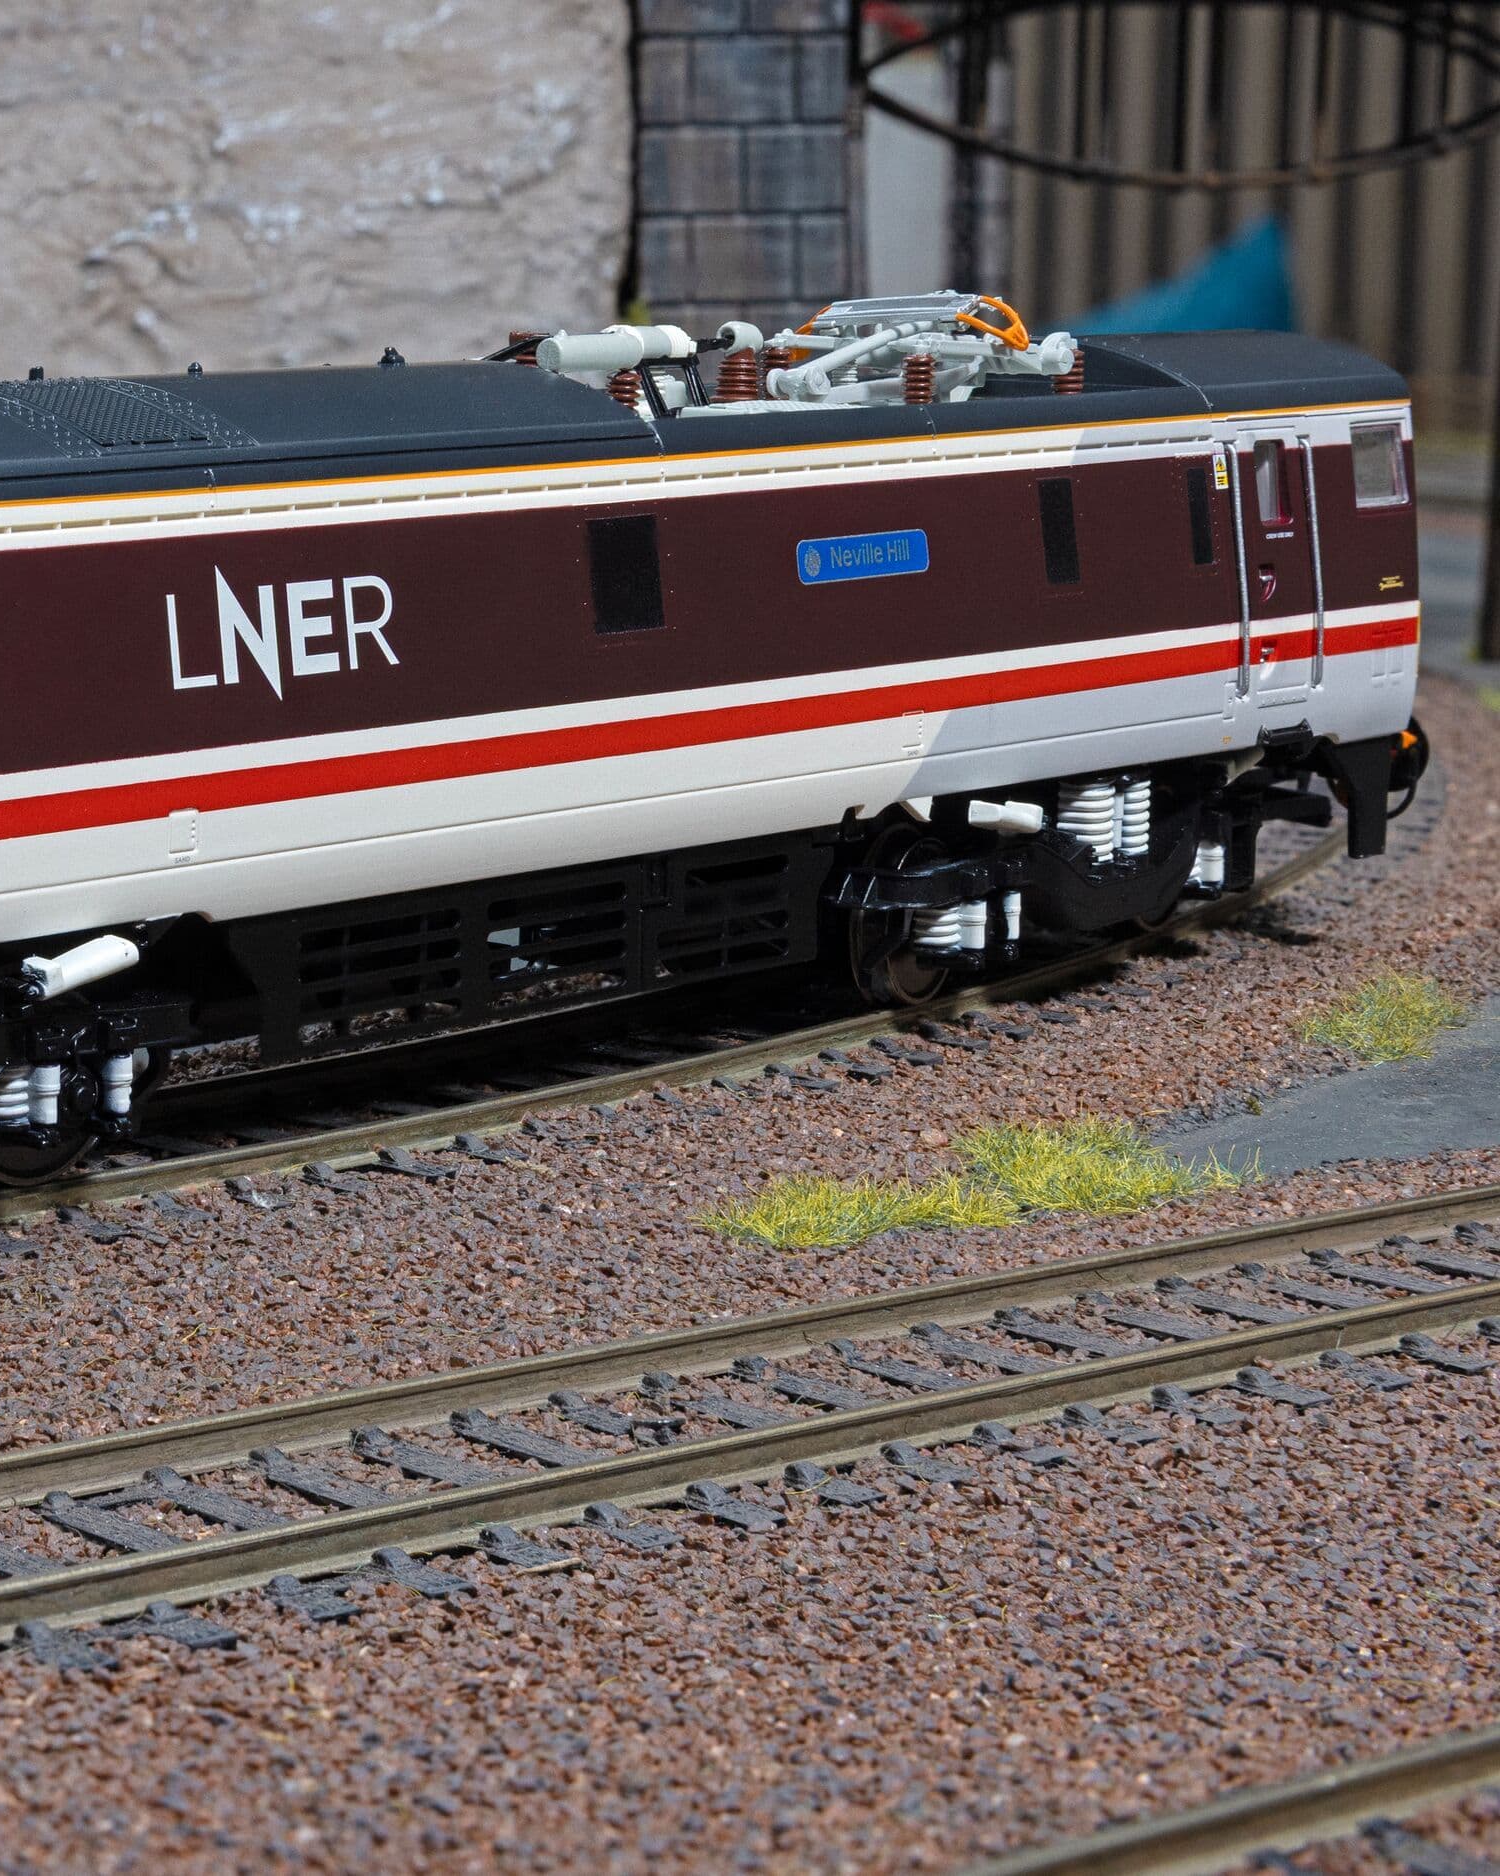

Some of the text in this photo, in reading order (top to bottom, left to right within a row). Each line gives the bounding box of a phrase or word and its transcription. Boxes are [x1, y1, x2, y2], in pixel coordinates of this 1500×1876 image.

[830, 537, 910, 568] Neville Hill
[166, 565, 400, 701] LNER
